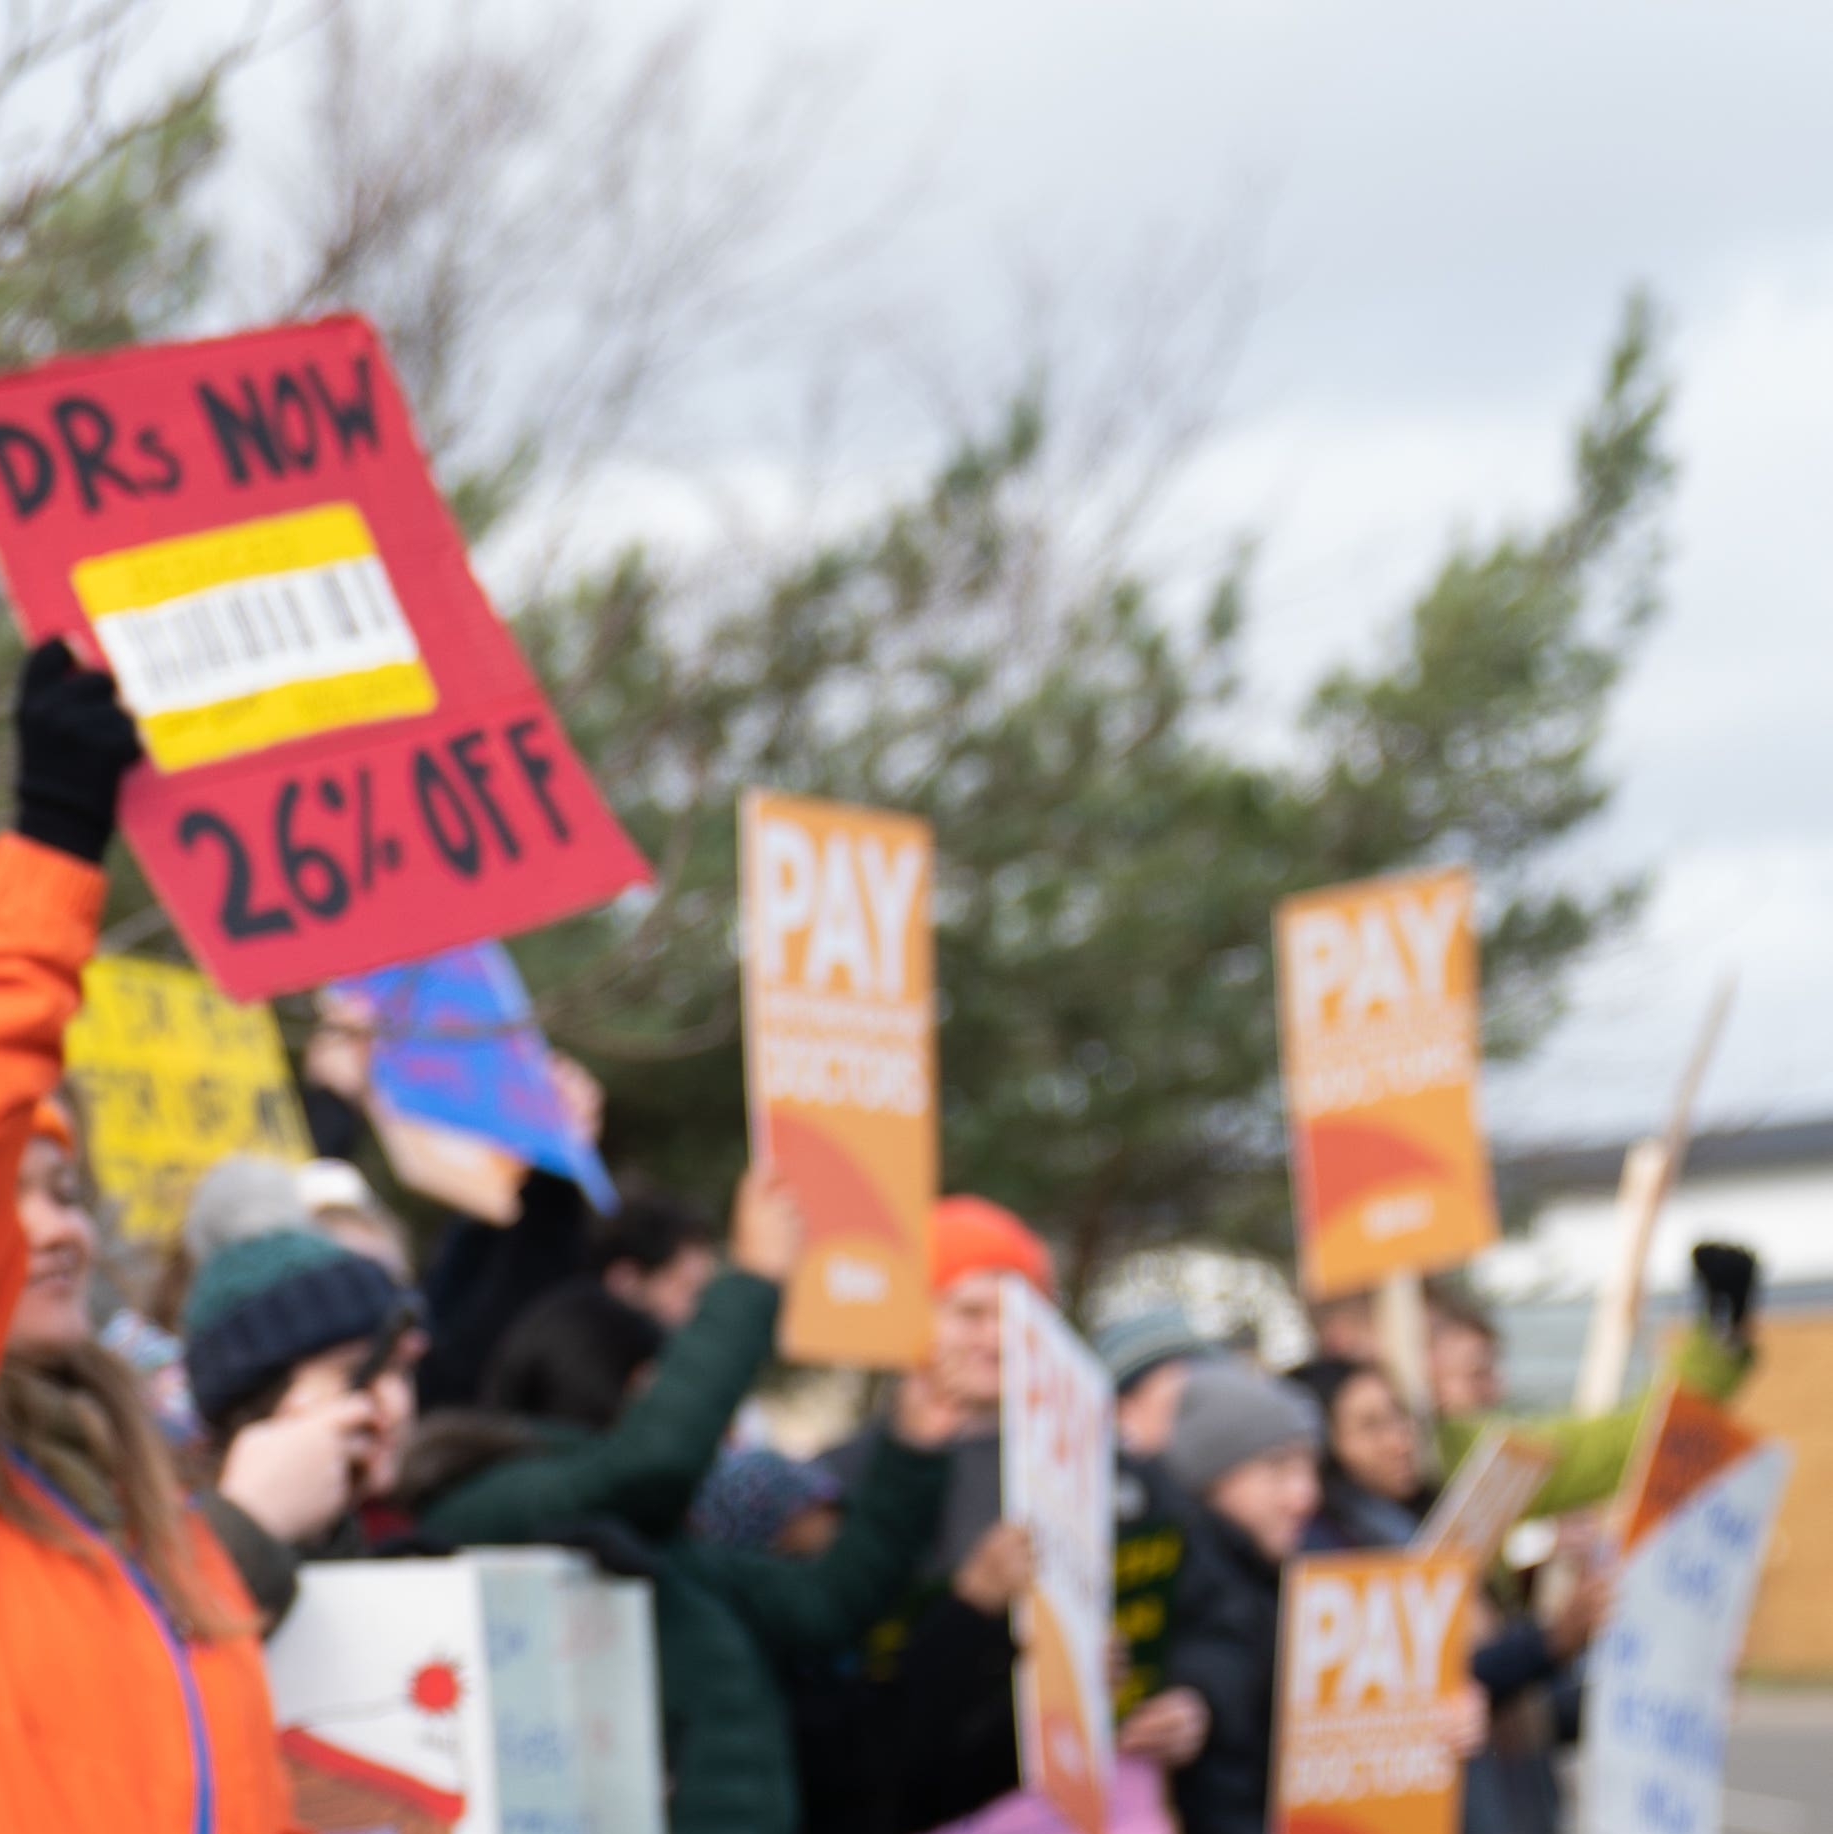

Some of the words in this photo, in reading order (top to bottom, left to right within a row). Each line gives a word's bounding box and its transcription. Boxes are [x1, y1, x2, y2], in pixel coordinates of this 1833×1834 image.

[194, 354, 384, 488] NOW
[177, 764, 403, 941] 26%
[411, 717, 572, 880] OFF
[757, 820, 927, 1000] PAY
[1288, 891, 1465, 1027] PAY
[1293, 1572, 1464, 1704] PAY
